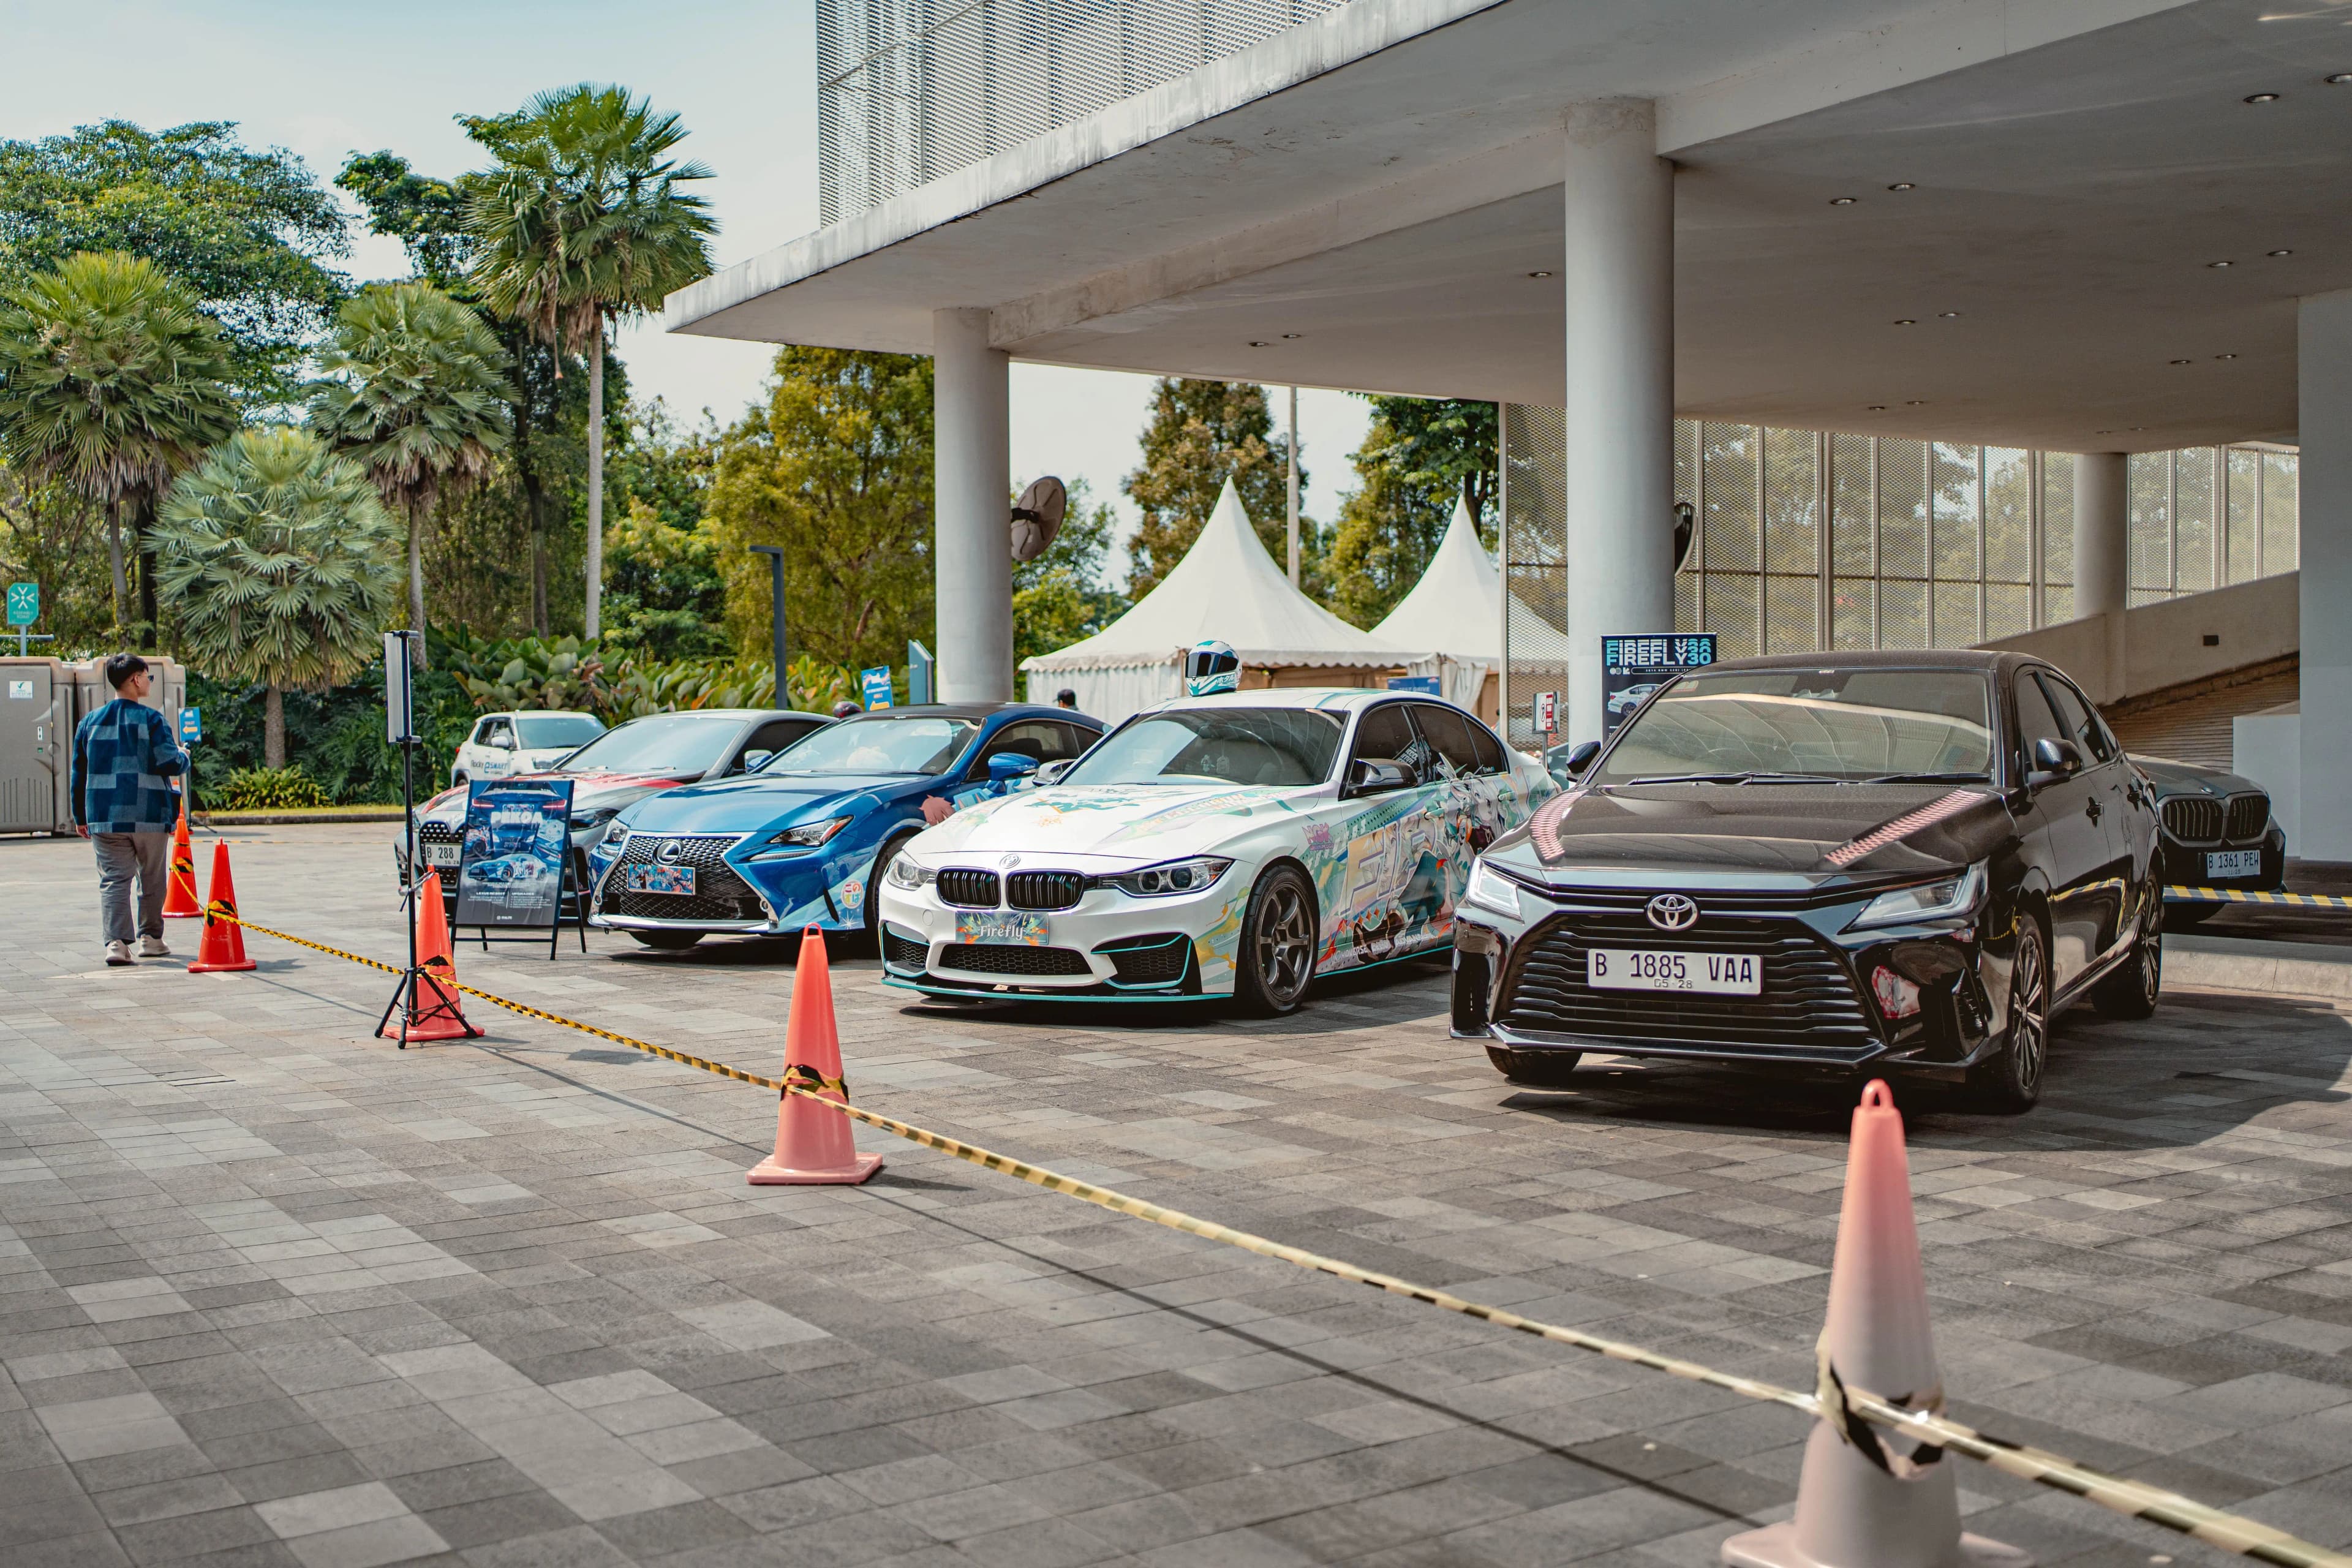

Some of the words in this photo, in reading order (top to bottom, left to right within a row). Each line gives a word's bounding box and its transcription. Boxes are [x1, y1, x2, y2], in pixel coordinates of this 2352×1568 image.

[427, 846, 432, 858] B
[438, 847, 454, 859] 288
[2208, 854, 2214, 869] B
[2218, 853, 2239, 869] 1361
[980, 924, 1023, 940] Firefly
[1595, 952, 1608, 977] B
[1630, 952, 1686, 979] 1885
[1708, 956, 1753, 983] VAA
